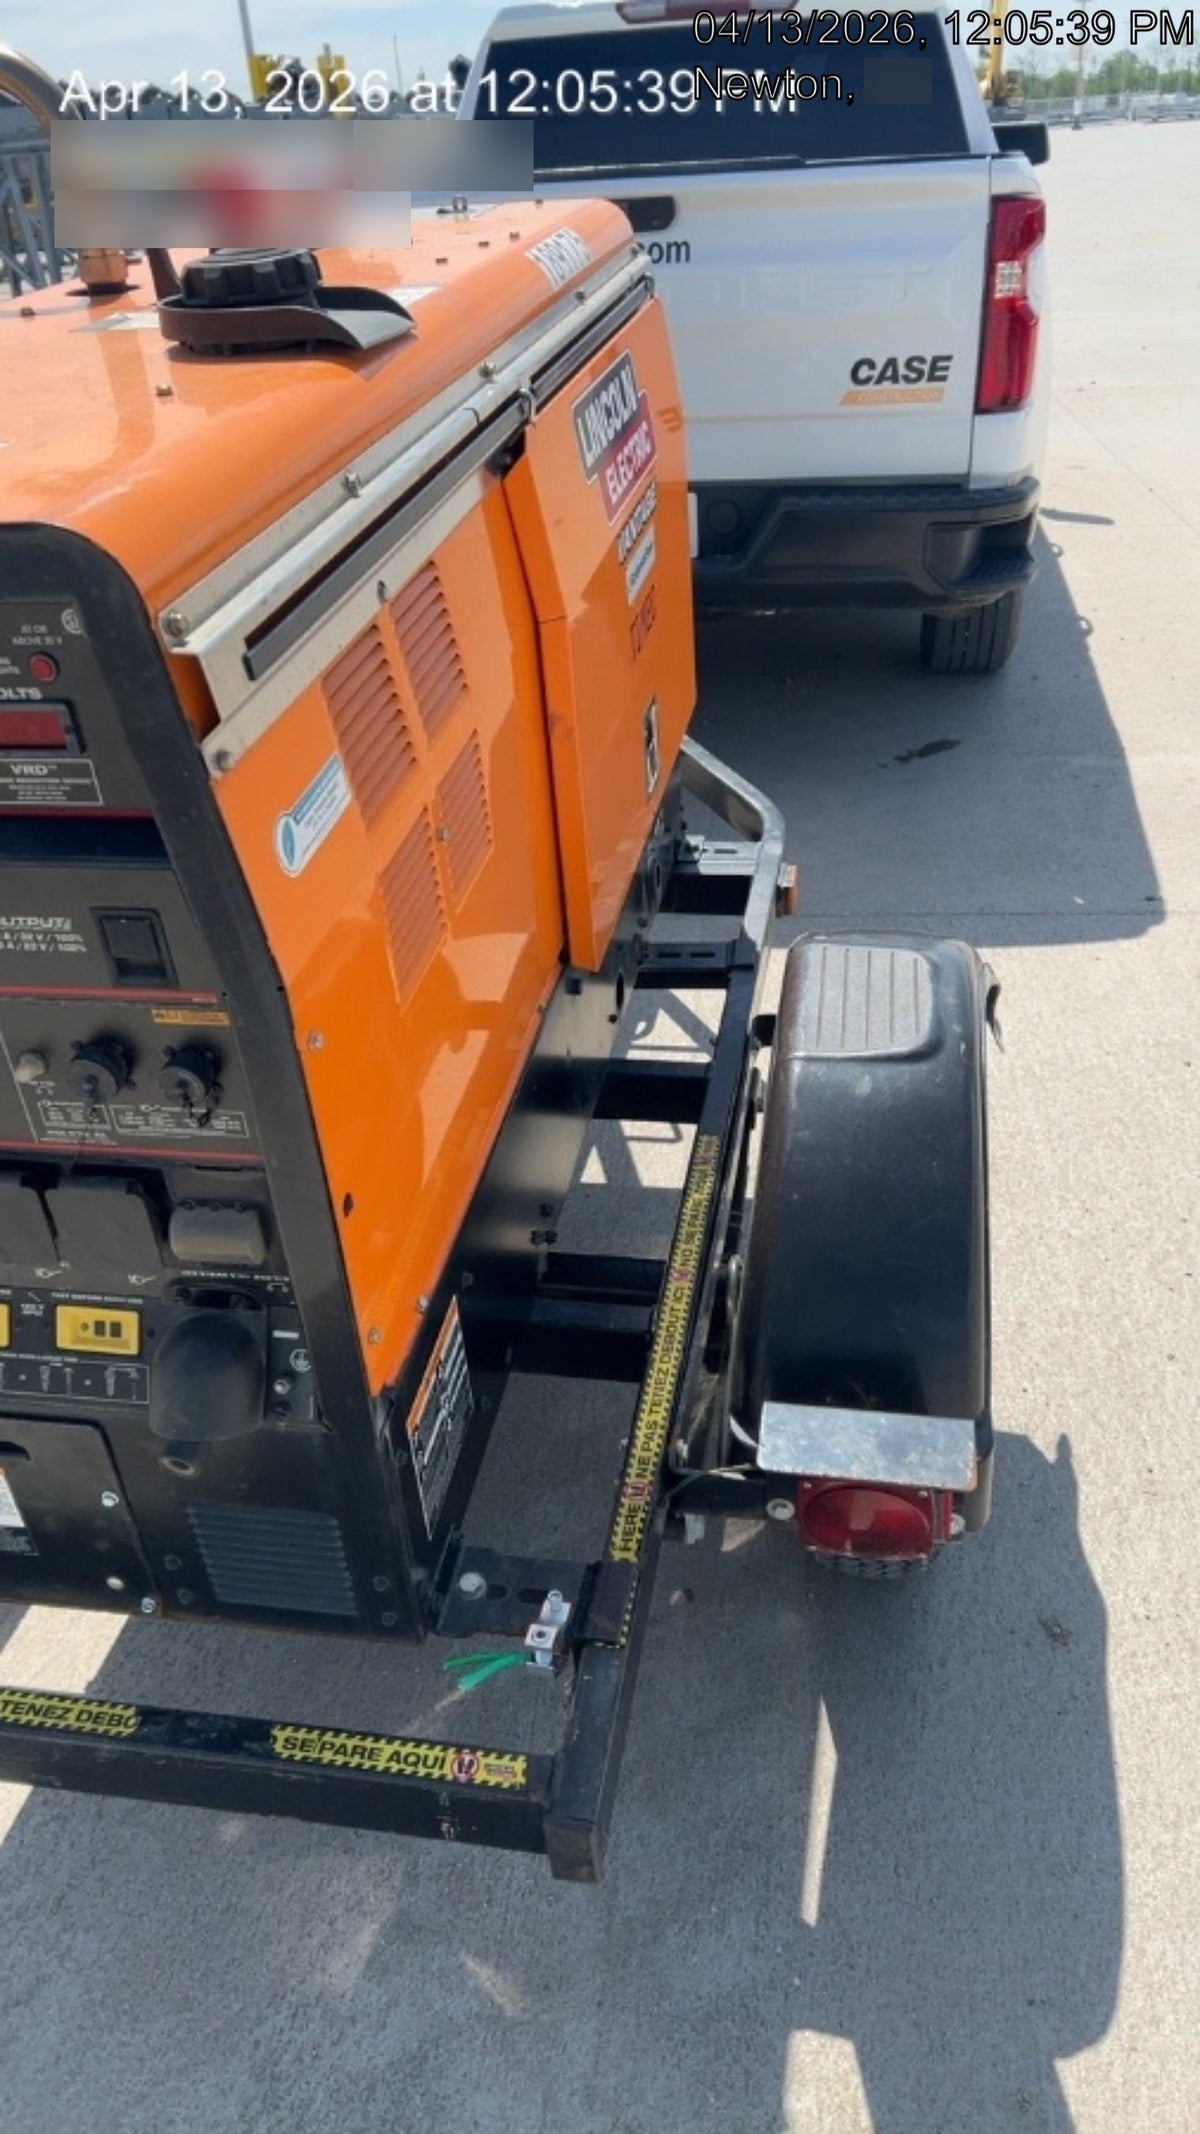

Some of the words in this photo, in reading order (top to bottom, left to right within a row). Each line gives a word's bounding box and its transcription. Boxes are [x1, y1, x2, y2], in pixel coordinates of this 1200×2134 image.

[638, 241, 691, 264] om
[850, 354, 954, 386] CASE
[577, 364, 638, 469] LINCOLN
[605, 421, 652, 506] ELECTRIC
[659, 1307, 681, 1364] DEBOUT
[649, 1367, 670, 1416] TENEZ
[641, 1420, 658, 1449] PAS
[636, 1456, 650, 1479] NE
[620, 1502, 642, 1552] HERE
[0, 1700, 73, 1721] TENEZ
[282, 1735, 316, 1752] SE
[317, 1738, 383, 1762] PARE
[386, 1750, 446, 1771] AQUI
